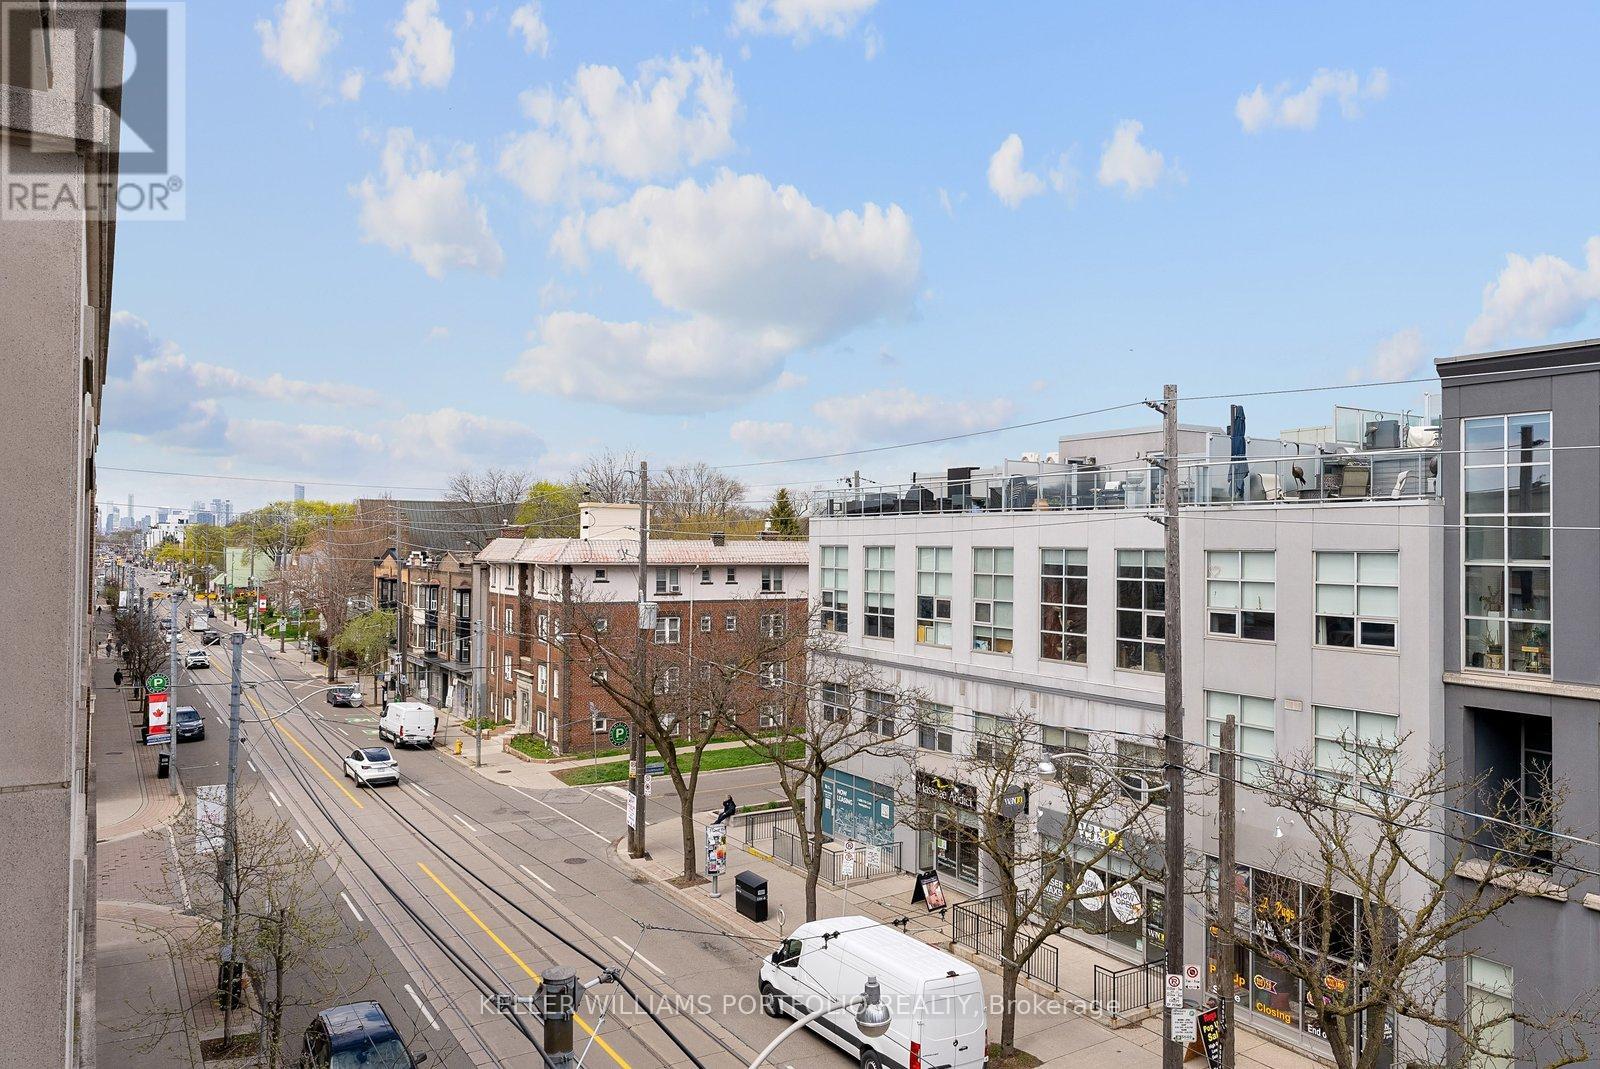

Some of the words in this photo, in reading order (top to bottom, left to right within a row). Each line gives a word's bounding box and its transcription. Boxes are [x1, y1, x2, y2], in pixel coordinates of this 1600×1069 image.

[153, 678, 163, 687] P
[615, 728, 625, 738] P
[836, 788, 848, 797] NOW
[836, 795, 853, 806] LEASING
[1256, 1002, 1292, 1024] Closing
[1307, 1023, 1321, 1037] End
[1207, 1031, 1219, 1042] Sal
